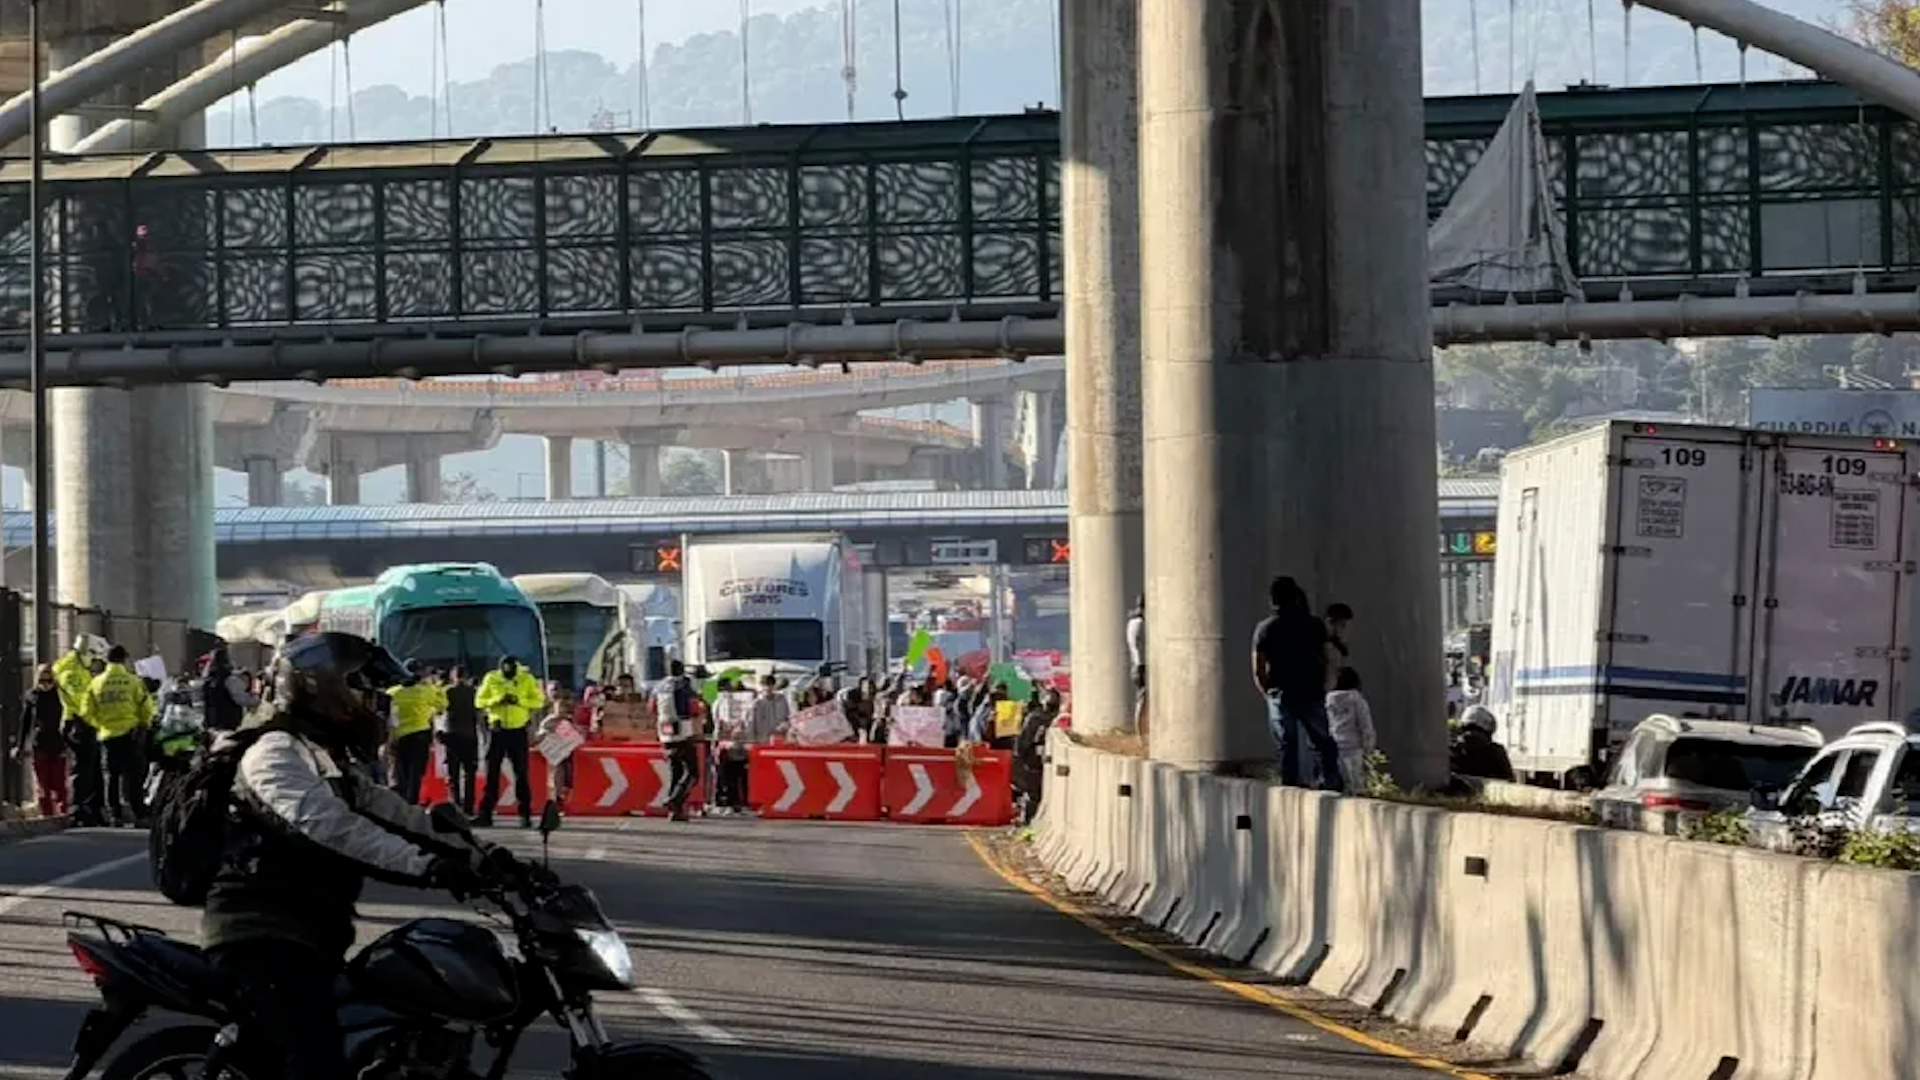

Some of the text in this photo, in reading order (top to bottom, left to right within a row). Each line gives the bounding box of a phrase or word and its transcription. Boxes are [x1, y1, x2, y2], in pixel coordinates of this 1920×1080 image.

[1660, 447, 1706, 467] 109
[1822, 455, 1866, 476] 109
[718, 583, 809, 597] CASTORES
[1769, 676, 1878, 707] JAMAR
